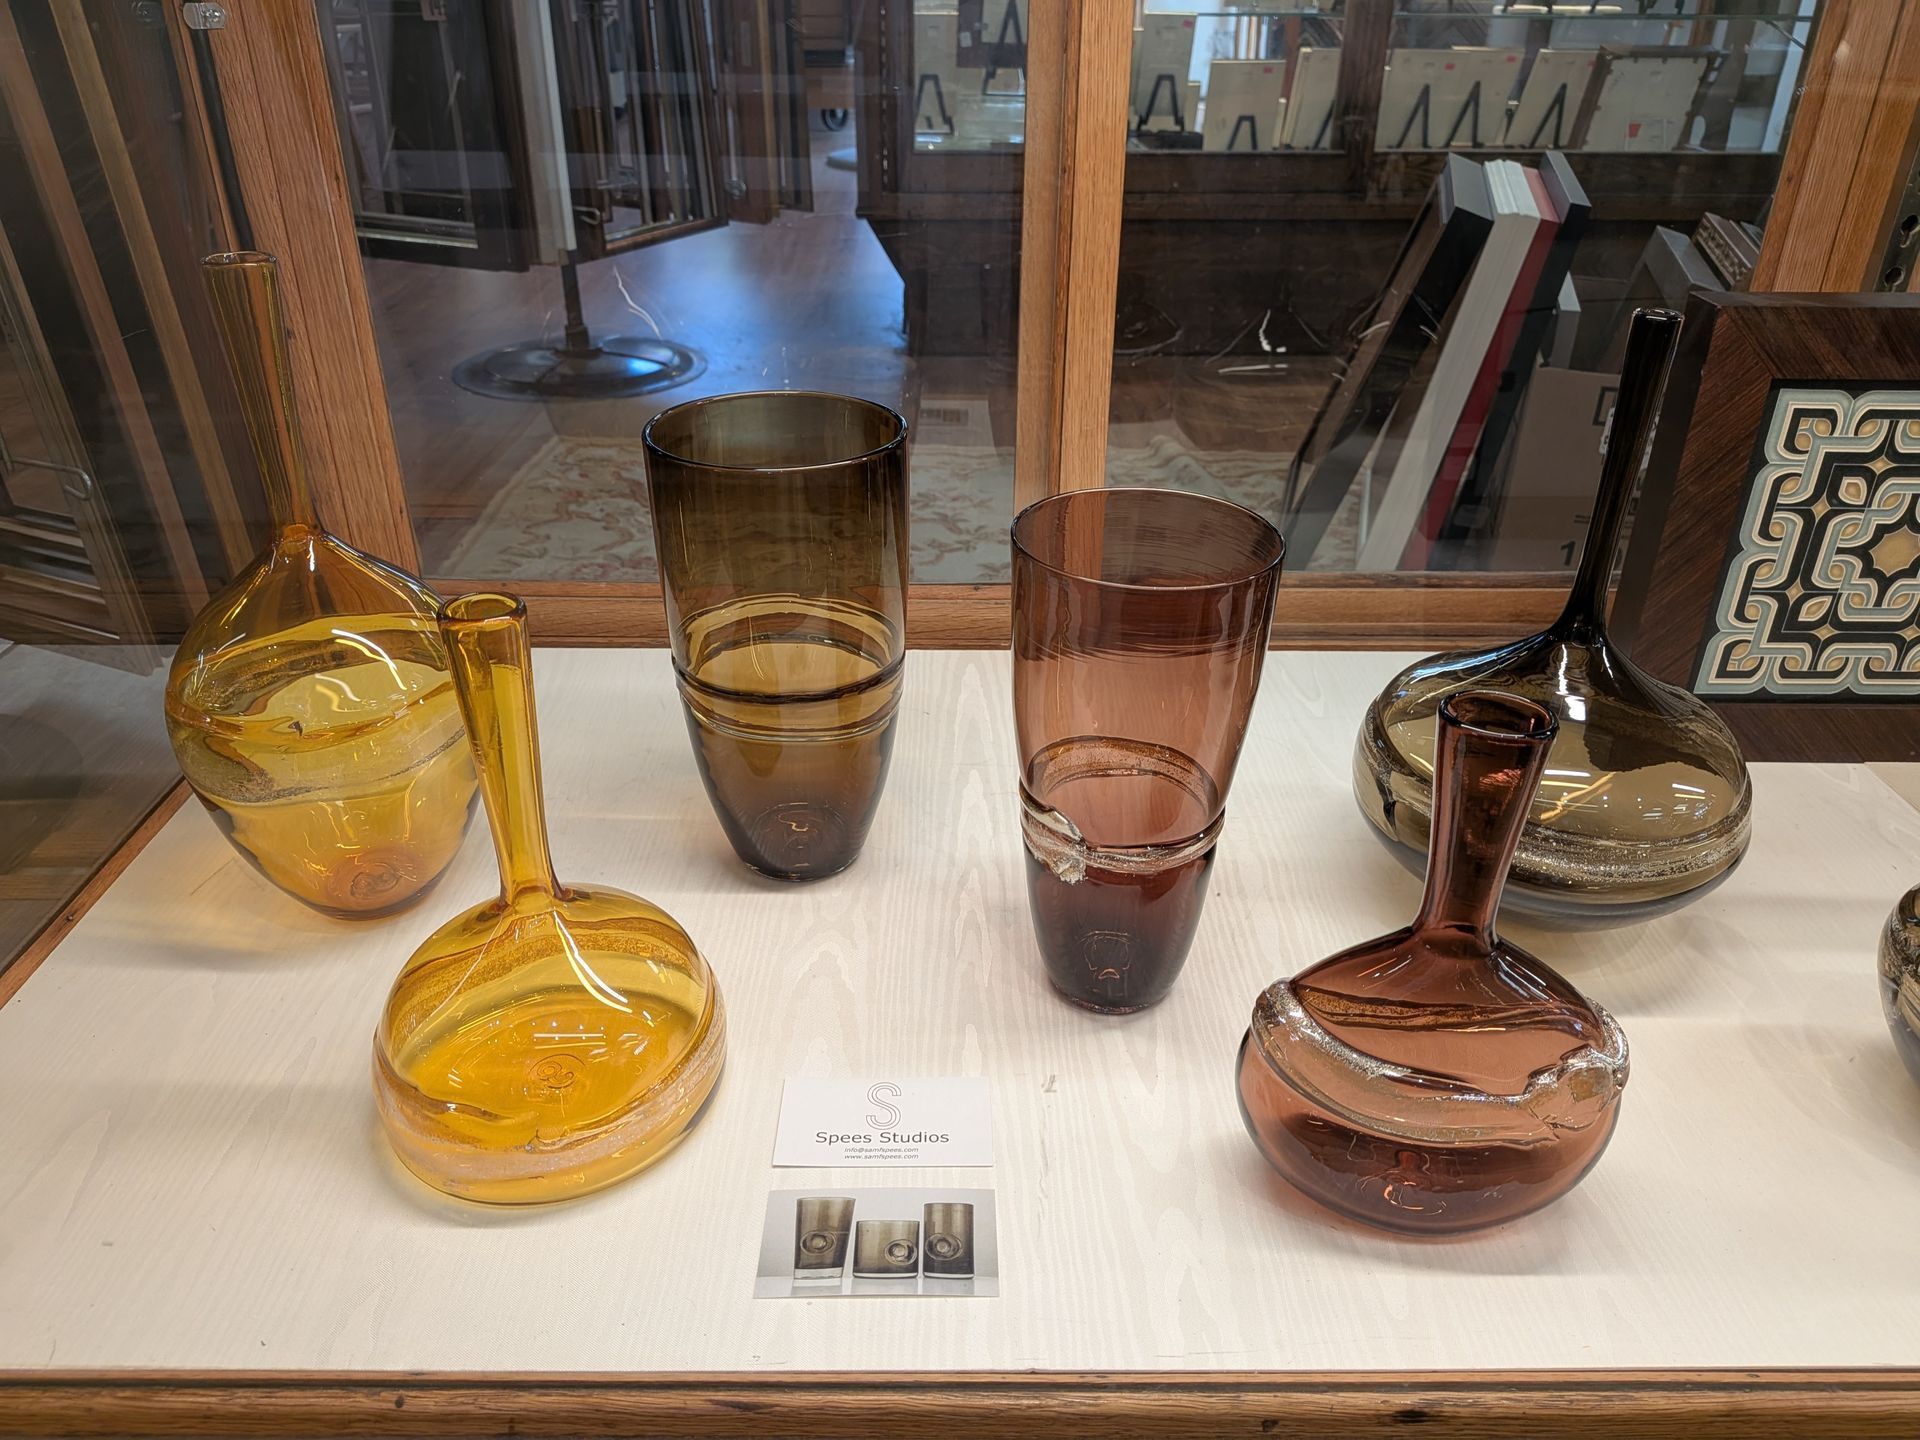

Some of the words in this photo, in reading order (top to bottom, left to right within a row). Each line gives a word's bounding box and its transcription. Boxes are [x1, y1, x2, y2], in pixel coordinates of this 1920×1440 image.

[866, 1082, 901, 1130] S
[816, 1131, 872, 1145] Spees
[879, 1131, 950, 1144] Studios
